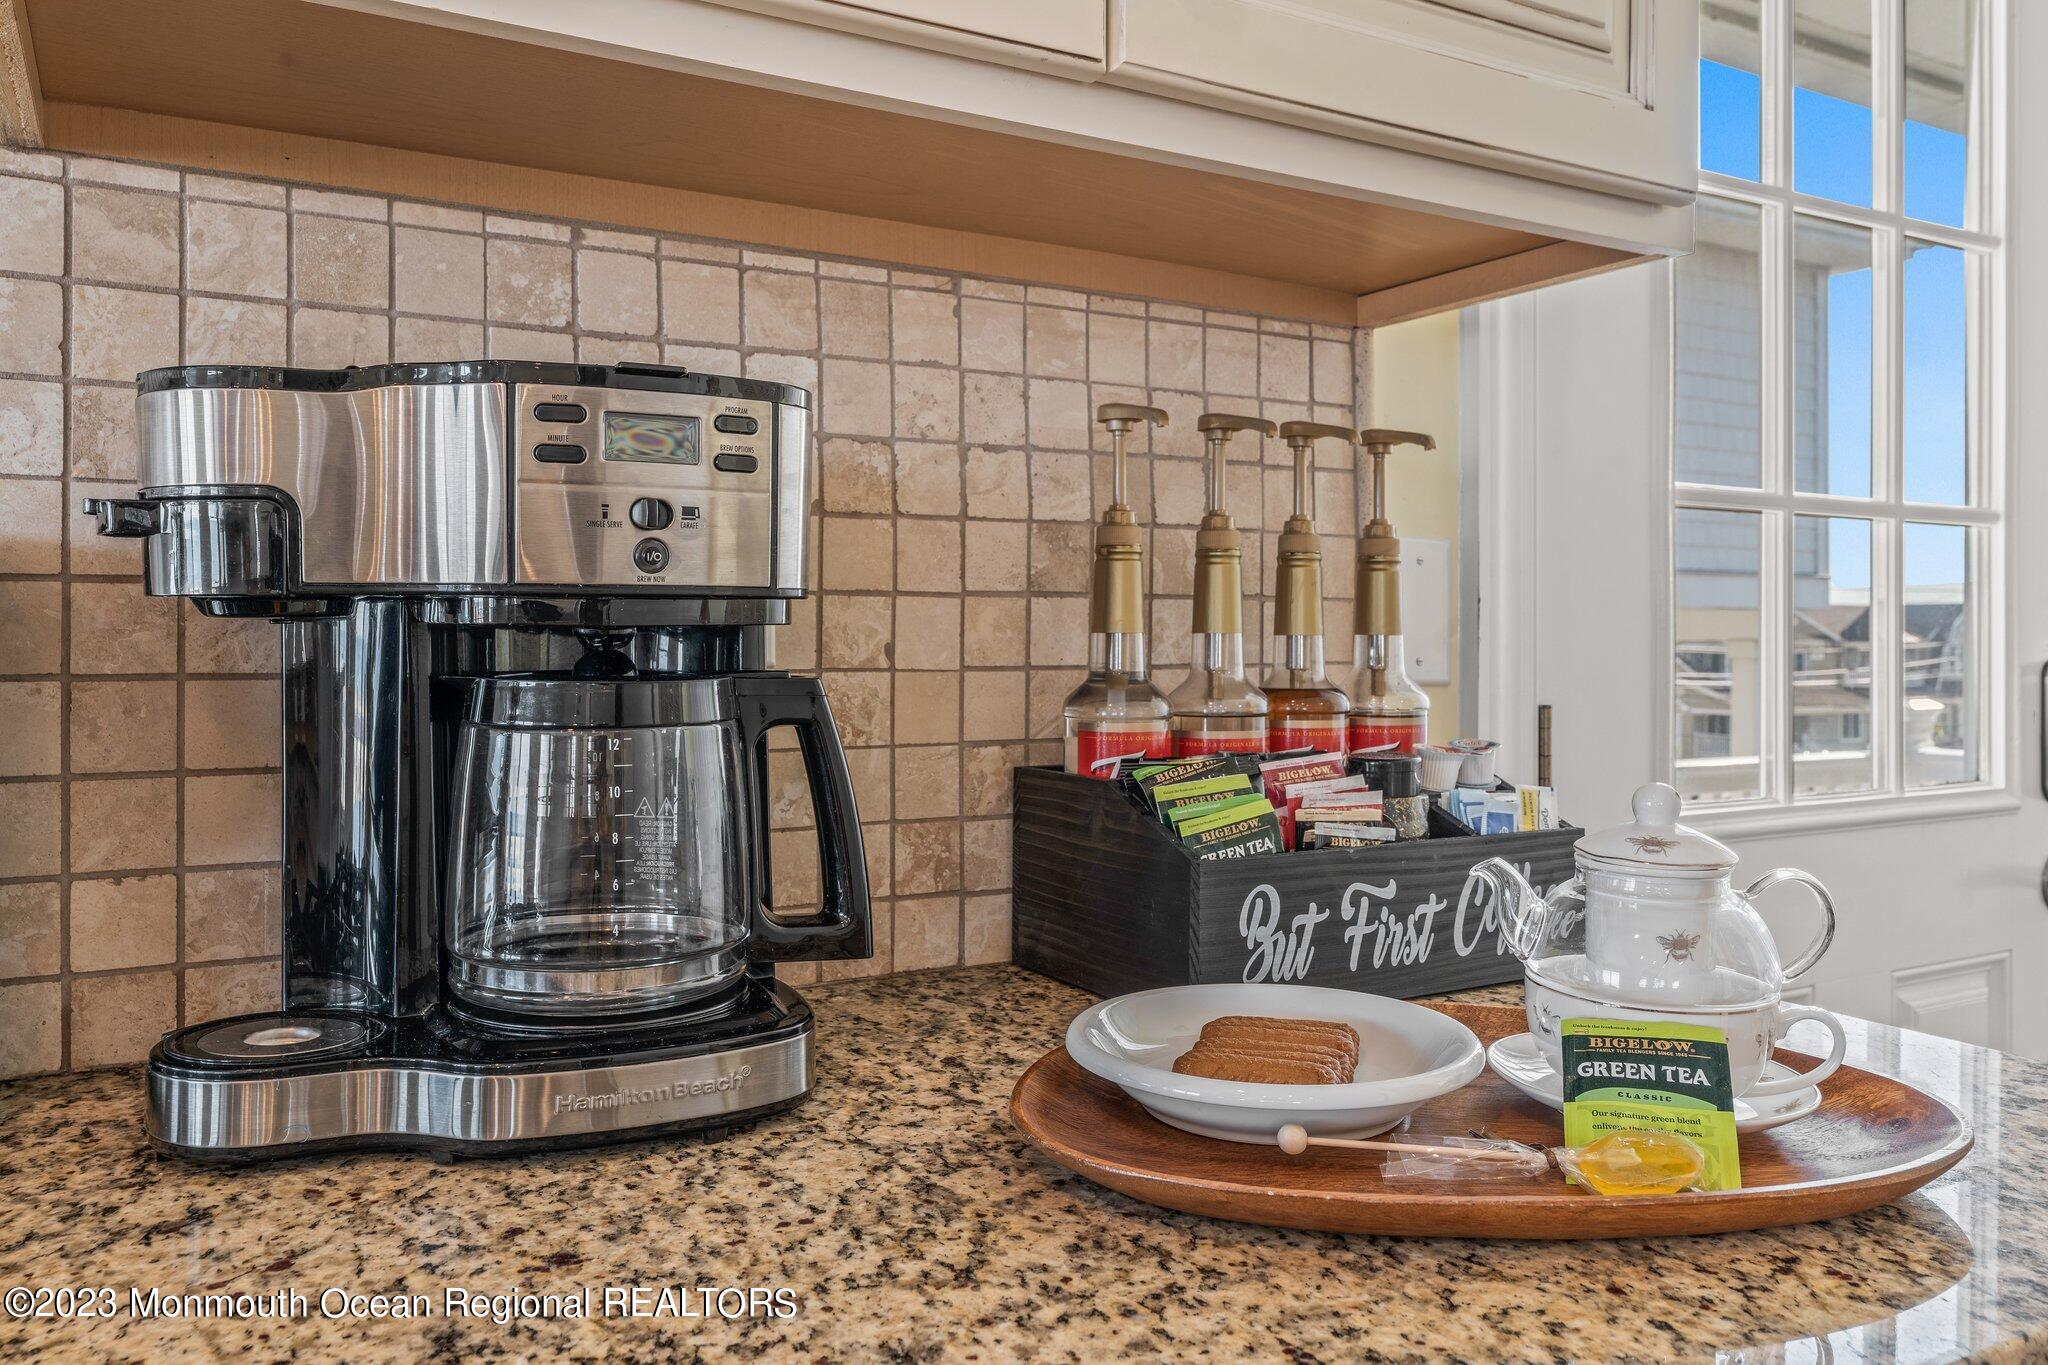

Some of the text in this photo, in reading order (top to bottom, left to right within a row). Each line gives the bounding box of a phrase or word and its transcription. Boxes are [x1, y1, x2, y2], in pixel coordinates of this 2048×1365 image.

[551, 394, 568, 402] HOUR
[725, 406, 748, 415] PROGRAM
[547, 435, 569, 443] MINUTE
[720, 444, 755, 454] BREW OPTIONS
[586, 520, 623, 528] SINGLE SERVE
[680, 521, 699, 530] CARAFE
[608, 738, 620, 751] 12
[1278, 765, 1332, 781] BIGELOW
[609, 786, 621, 798] 10
[1201, 818, 1260, 842] BIGELOW
[612, 832, 619, 845] 8
[1247, 837, 1274, 855] TEA
[613, 879, 619, 891] 6
[612, 924, 619, 936] 4
[1239, 884, 1330, 984] But
[1341, 878, 1448, 972] First
[1589, 1037, 1693, 1052] BIGELOW
[1577, 1061, 1712, 1087] GREEN TEA
[1617, 1091, 1673, 1102] CLASSIC
[1591, 1109, 1701, 1125] Our signature green blend
